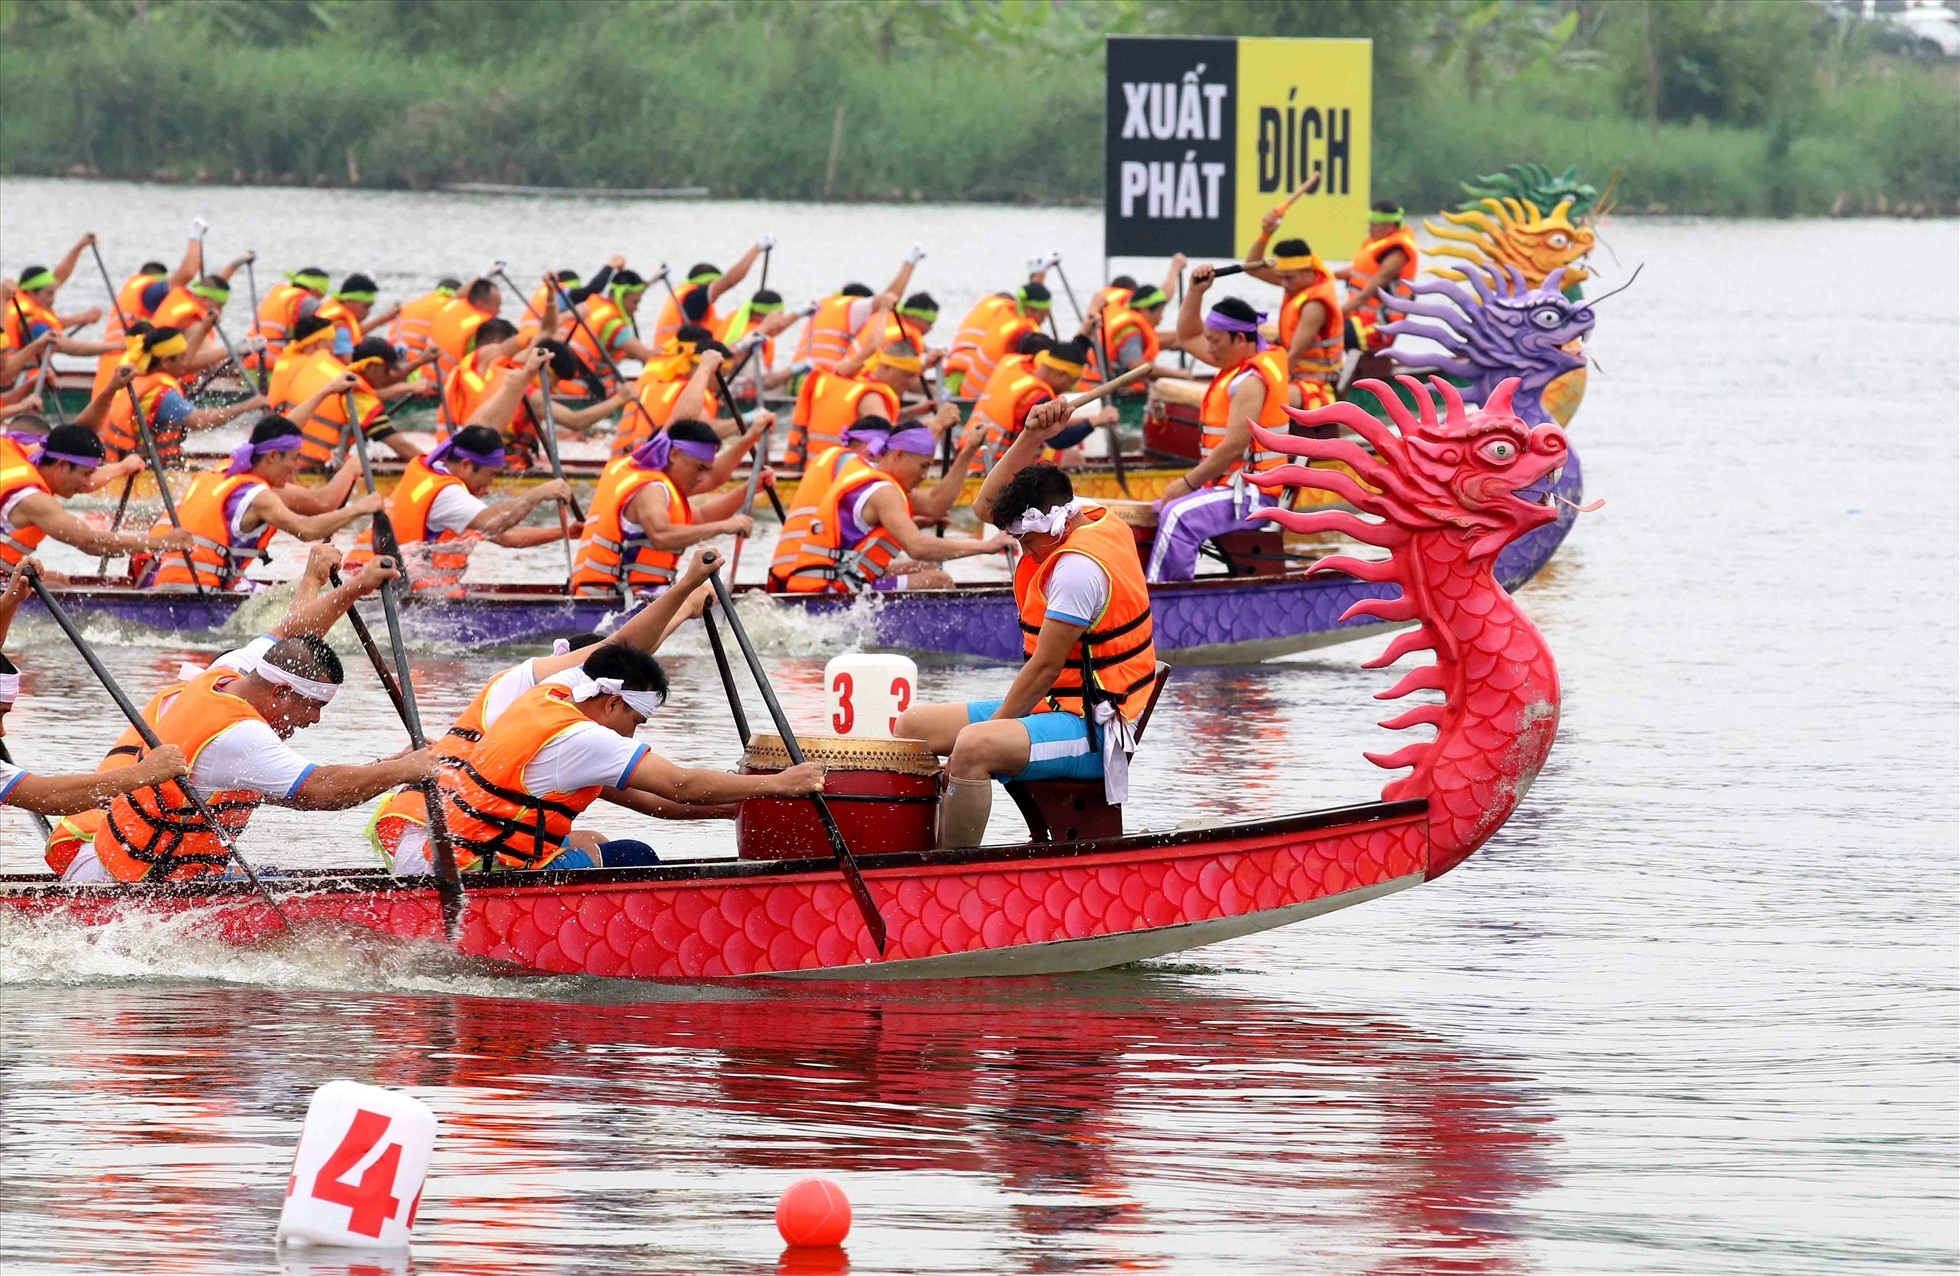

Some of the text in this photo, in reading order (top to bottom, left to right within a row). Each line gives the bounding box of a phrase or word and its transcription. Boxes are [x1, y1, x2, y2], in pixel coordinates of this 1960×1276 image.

[1121, 63, 1227, 140] XUẤT
[1258, 87, 1350, 195] ĐÍCH
[1120, 150, 1226, 219] PHÁT
[833, 672, 854, 734] 3
[311, 1108, 403, 1239] 4
